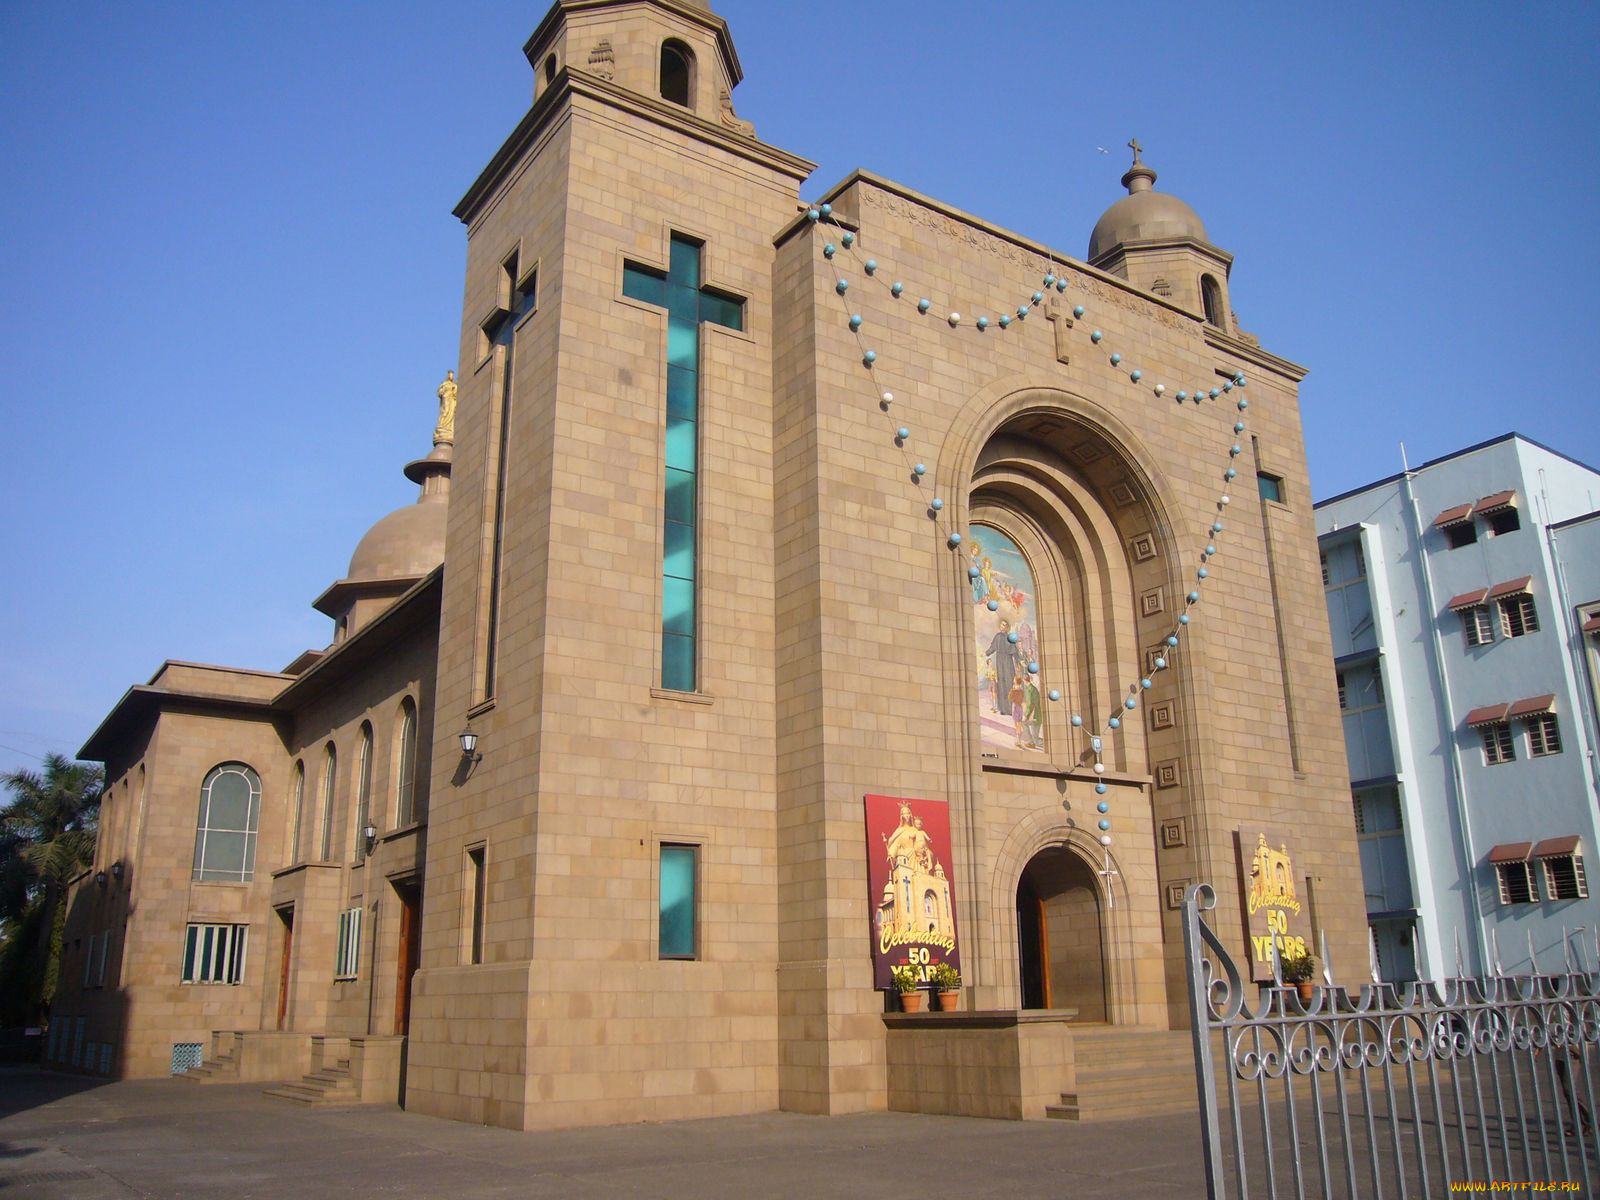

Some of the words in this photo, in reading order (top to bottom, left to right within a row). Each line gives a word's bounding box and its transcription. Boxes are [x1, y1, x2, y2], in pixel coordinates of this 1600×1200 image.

[1249, 891, 1301, 917] Celebrating
[1266, 909, 1288, 935] 50
[880, 921, 956, 957] Celebrating
[908, 947, 931, 965] 50
[890, 965, 941, 982] YEAR
